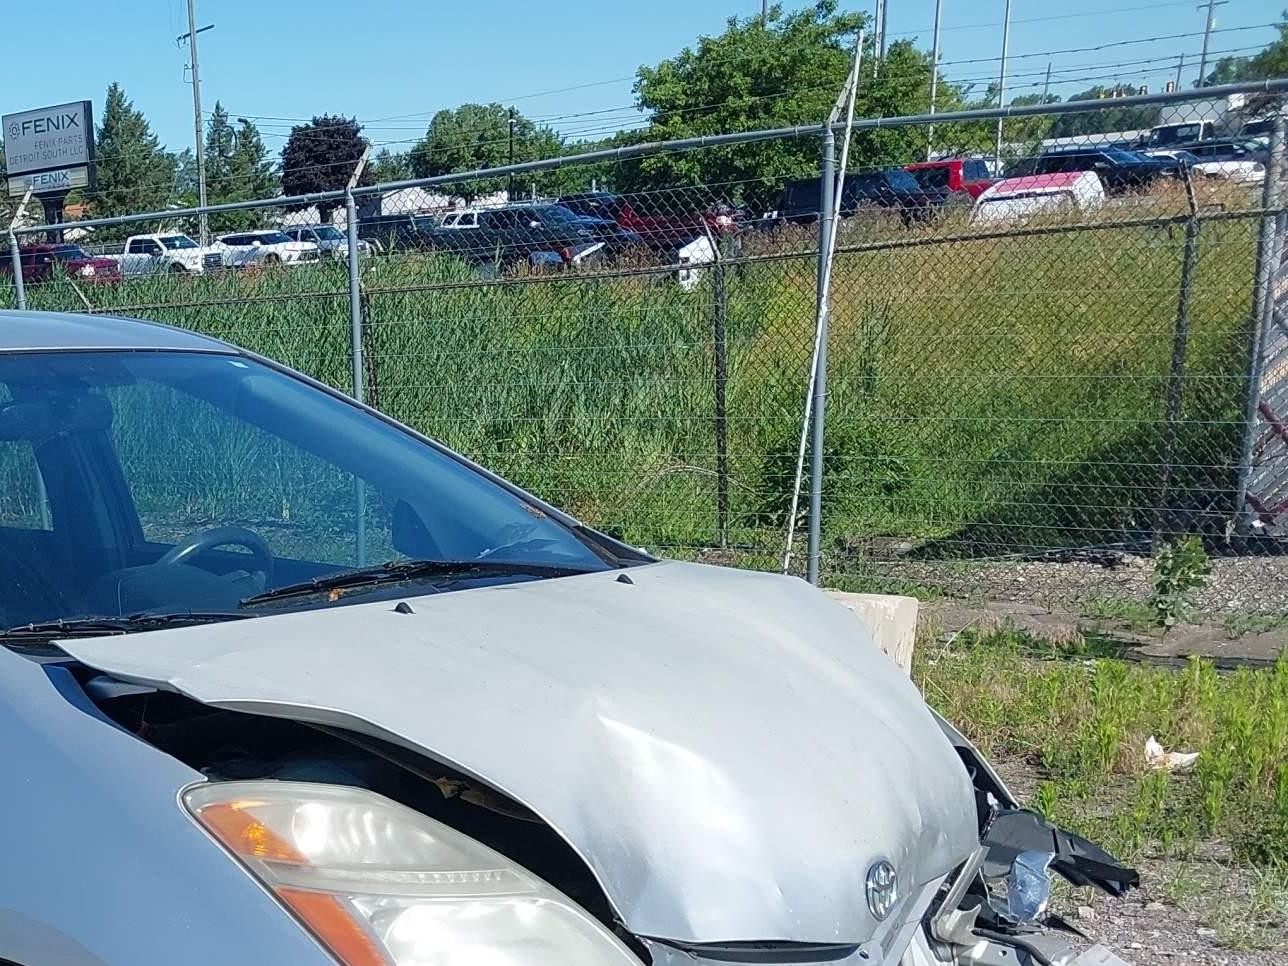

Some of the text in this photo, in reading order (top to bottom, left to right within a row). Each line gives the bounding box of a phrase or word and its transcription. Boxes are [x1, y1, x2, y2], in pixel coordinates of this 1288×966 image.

[22, 113, 78, 136] FENIX
[34, 135, 82, 150] FENIX PARTS
[10, 146, 82, 164] DETROIT SOUTH LLC
[33, 171, 69, 185] FENIX
